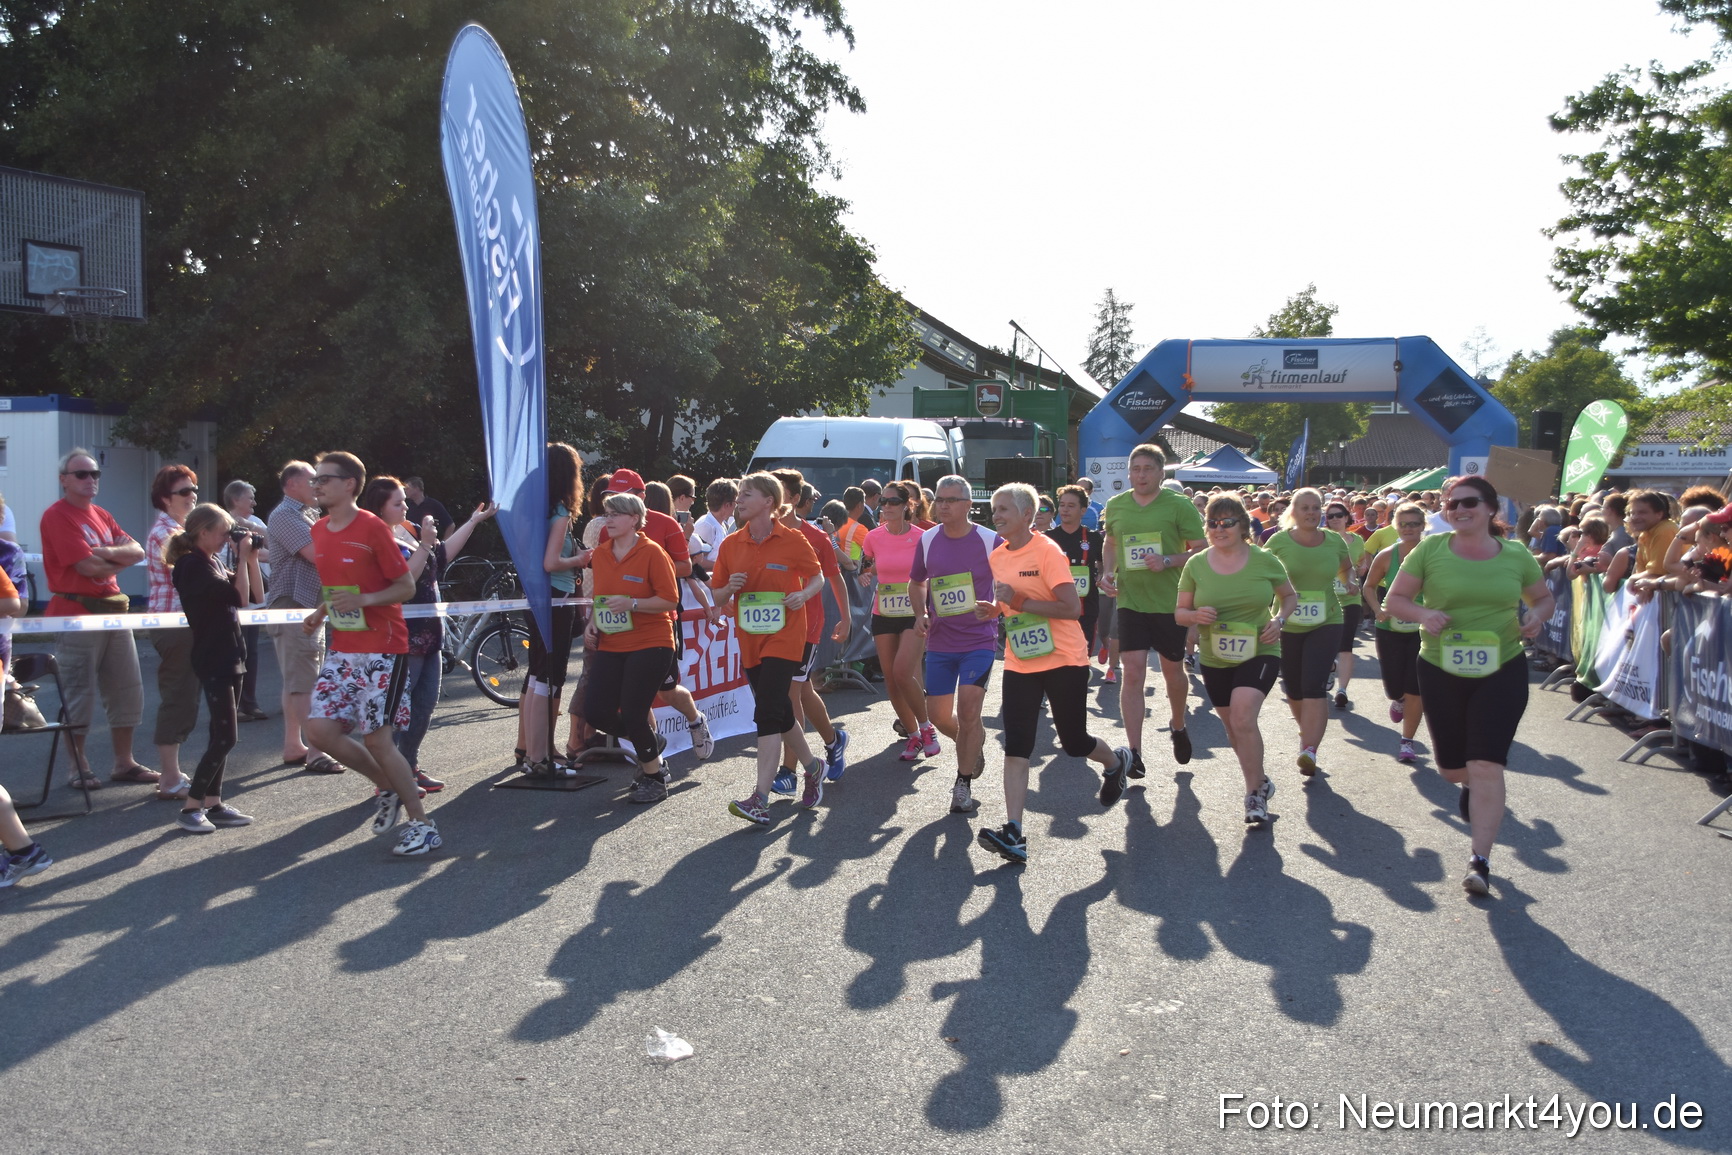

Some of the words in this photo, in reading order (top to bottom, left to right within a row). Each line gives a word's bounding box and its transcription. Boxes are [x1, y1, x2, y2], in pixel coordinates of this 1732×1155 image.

[1270, 369, 1348, 384] firmenlauf
[1126, 397, 1166, 407] Fischer
[1593, 434, 1616, 461] AOK
[1633, 447, 1665, 458] Jura
[1565, 453, 1594, 482] AOK
[882, 596, 912, 608] 1178
[940, 589, 966, 606] 290
[598, 611, 628, 624] 1038
[743, 608, 781, 623] 1032
[1293, 605, 1318, 617] 516
[1011, 627, 1048, 648] 1453
[1218, 637, 1247, 652] 517
[678, 617, 741, 693] EIER
[1452, 649, 1488, 665] 519
